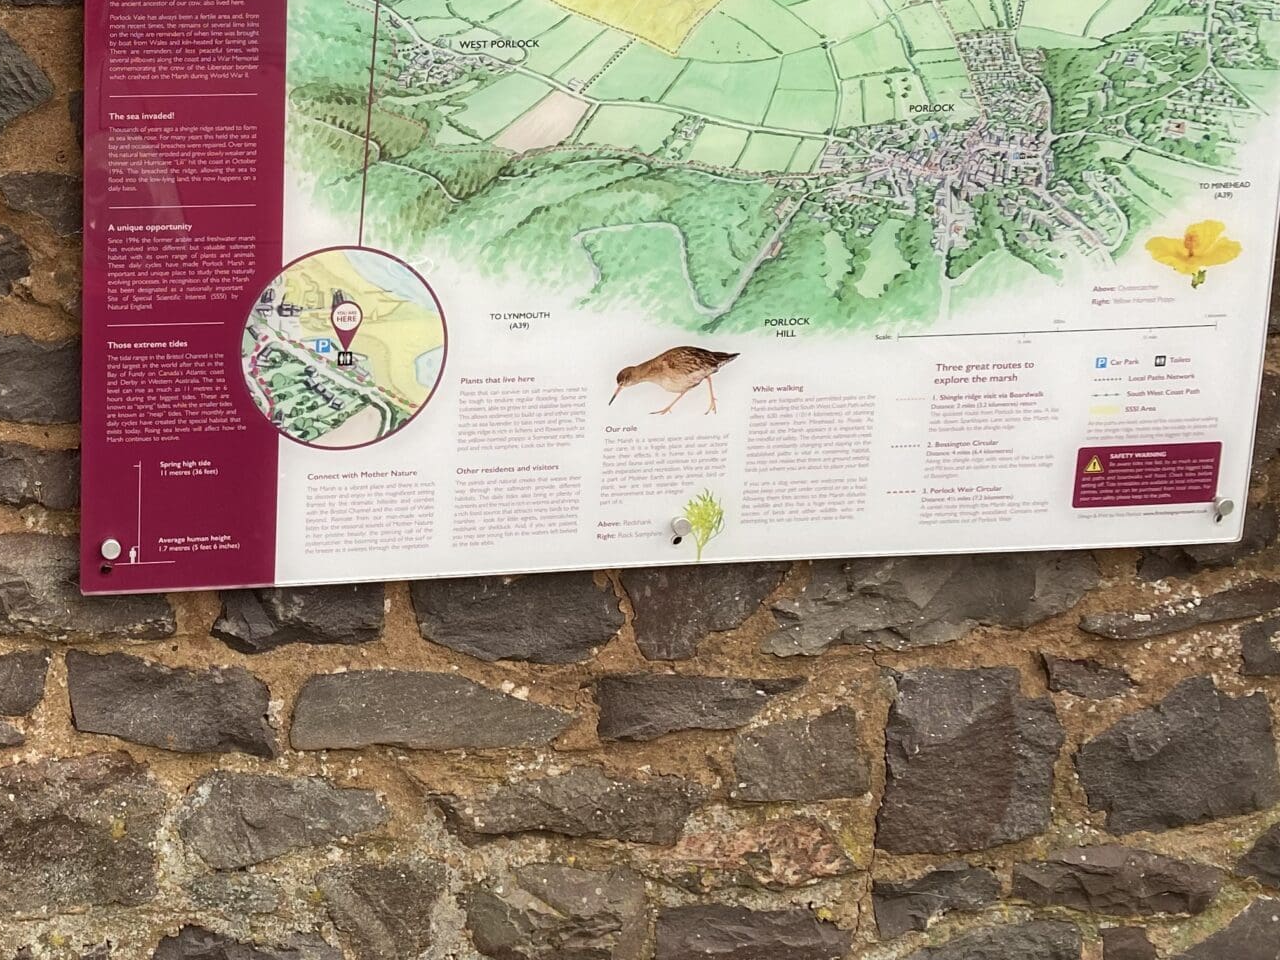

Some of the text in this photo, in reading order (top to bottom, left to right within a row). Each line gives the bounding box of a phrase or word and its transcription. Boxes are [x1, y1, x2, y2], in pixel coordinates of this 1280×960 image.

[459, 39, 540, 49] WEST PORLOCK
[909, 103, 955, 113] PORLOCK
[141, 112, 175, 120] invaded!
[1210, 181, 1251, 190] MINEHEAD
[1214, 191, 1233, 200] (A39)
[108, 223, 193, 233] A unique opportunity
[503, 311, 550, 320] LYNMOUTH
[509, 322, 529, 331] (A39)
[764, 317, 810, 327] PORLOCK
[776, 330, 796, 338] HILL
[107, 341, 132, 349] Those
[133, 341, 167, 349] extreme
[936, 361, 1034, 373] Three great routes to
[934, 374, 1018, 386] explore the marsh
[776, 384, 804, 393] walking
[605, 425, 620, 433] Our
[160, 461, 181, 469] Spring
[182, 461, 194, 469] high
[158, 537, 185, 545] Average
[210, 535, 232, 543] height
